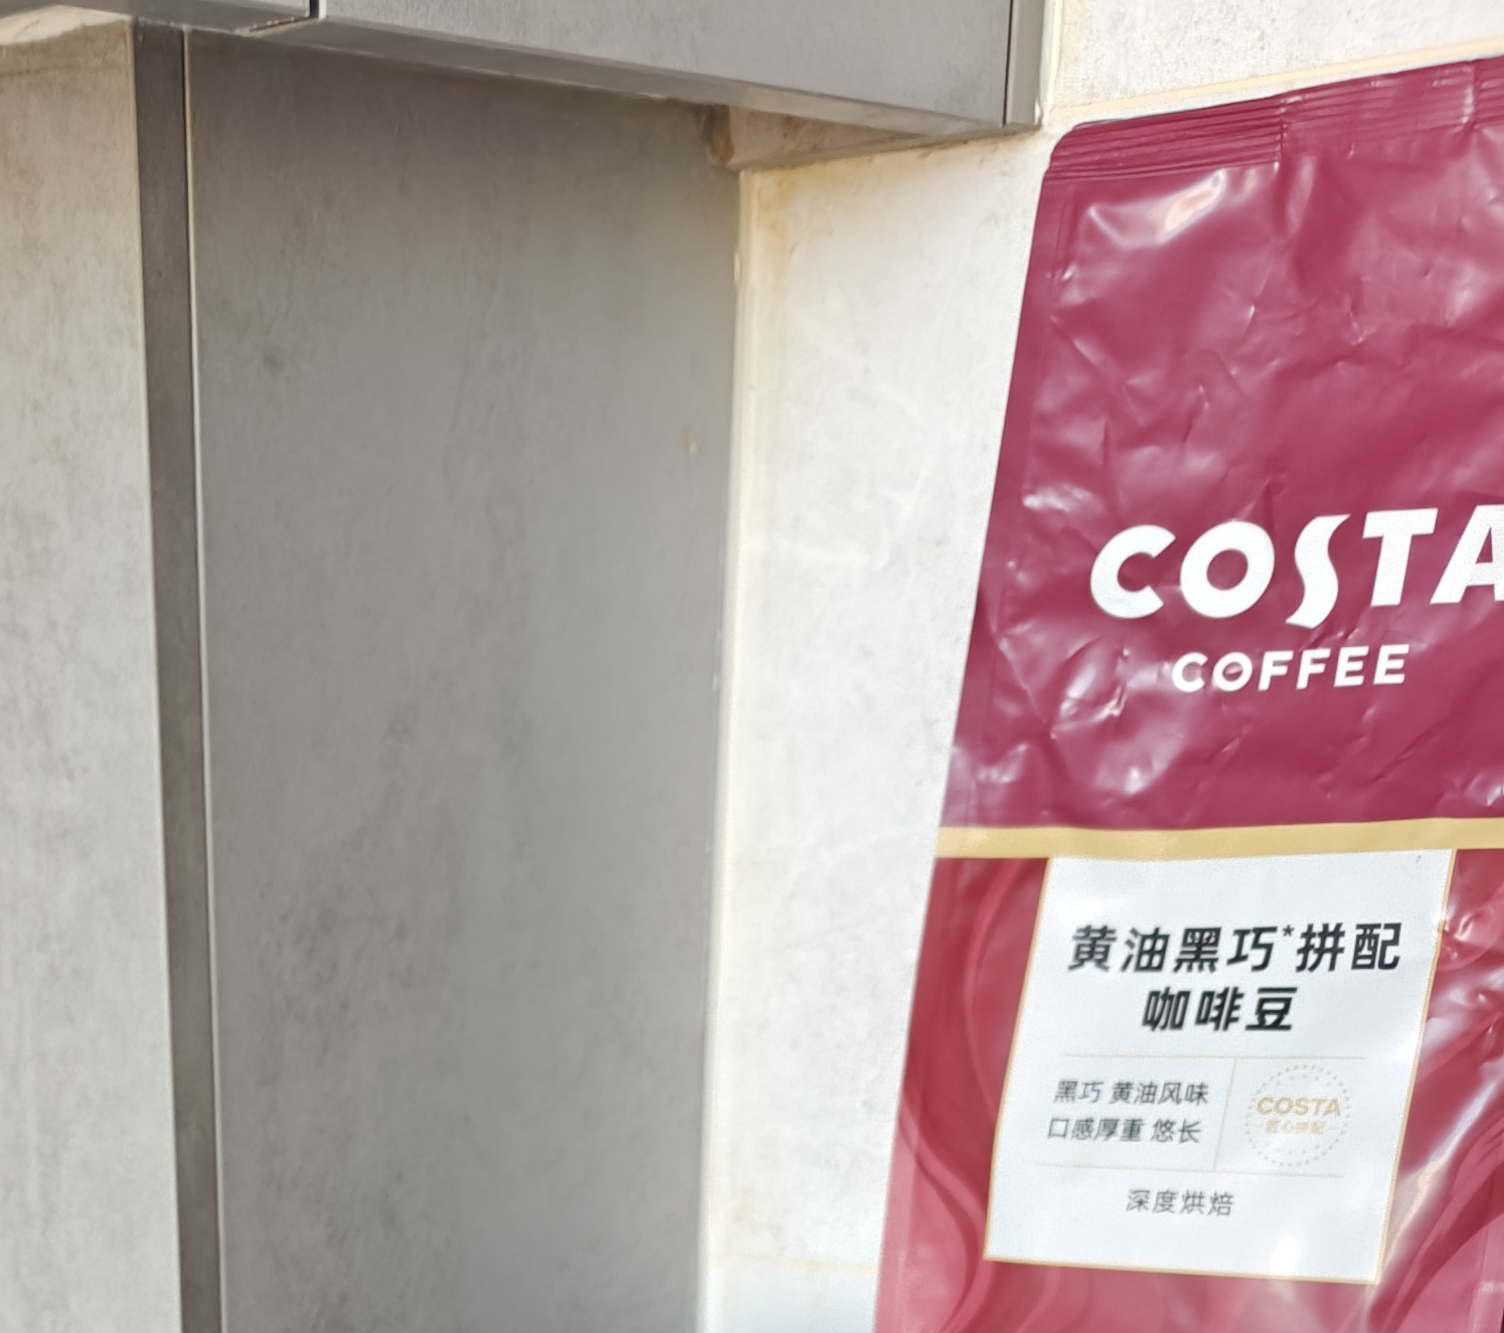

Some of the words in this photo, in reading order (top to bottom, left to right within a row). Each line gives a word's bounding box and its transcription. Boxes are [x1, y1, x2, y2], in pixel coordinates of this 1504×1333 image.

[1090, 505, 1504, 629] COSTA
[1172, 644, 1410, 692] COFFEE
[1141, 986, 1299, 1032] 咖啡豆
[1053, 1079, 1105, 1105] 黑巧
[1109, 1080, 1210, 1106] 黄油风味
[1256, 1096, 1342, 1117] COSTA
[1047, 1117, 1144, 1143] 口感厚重
[1150, 1120, 1203, 1144] 悠长
[1126, 1188, 1235, 1217] 深度烘焙
